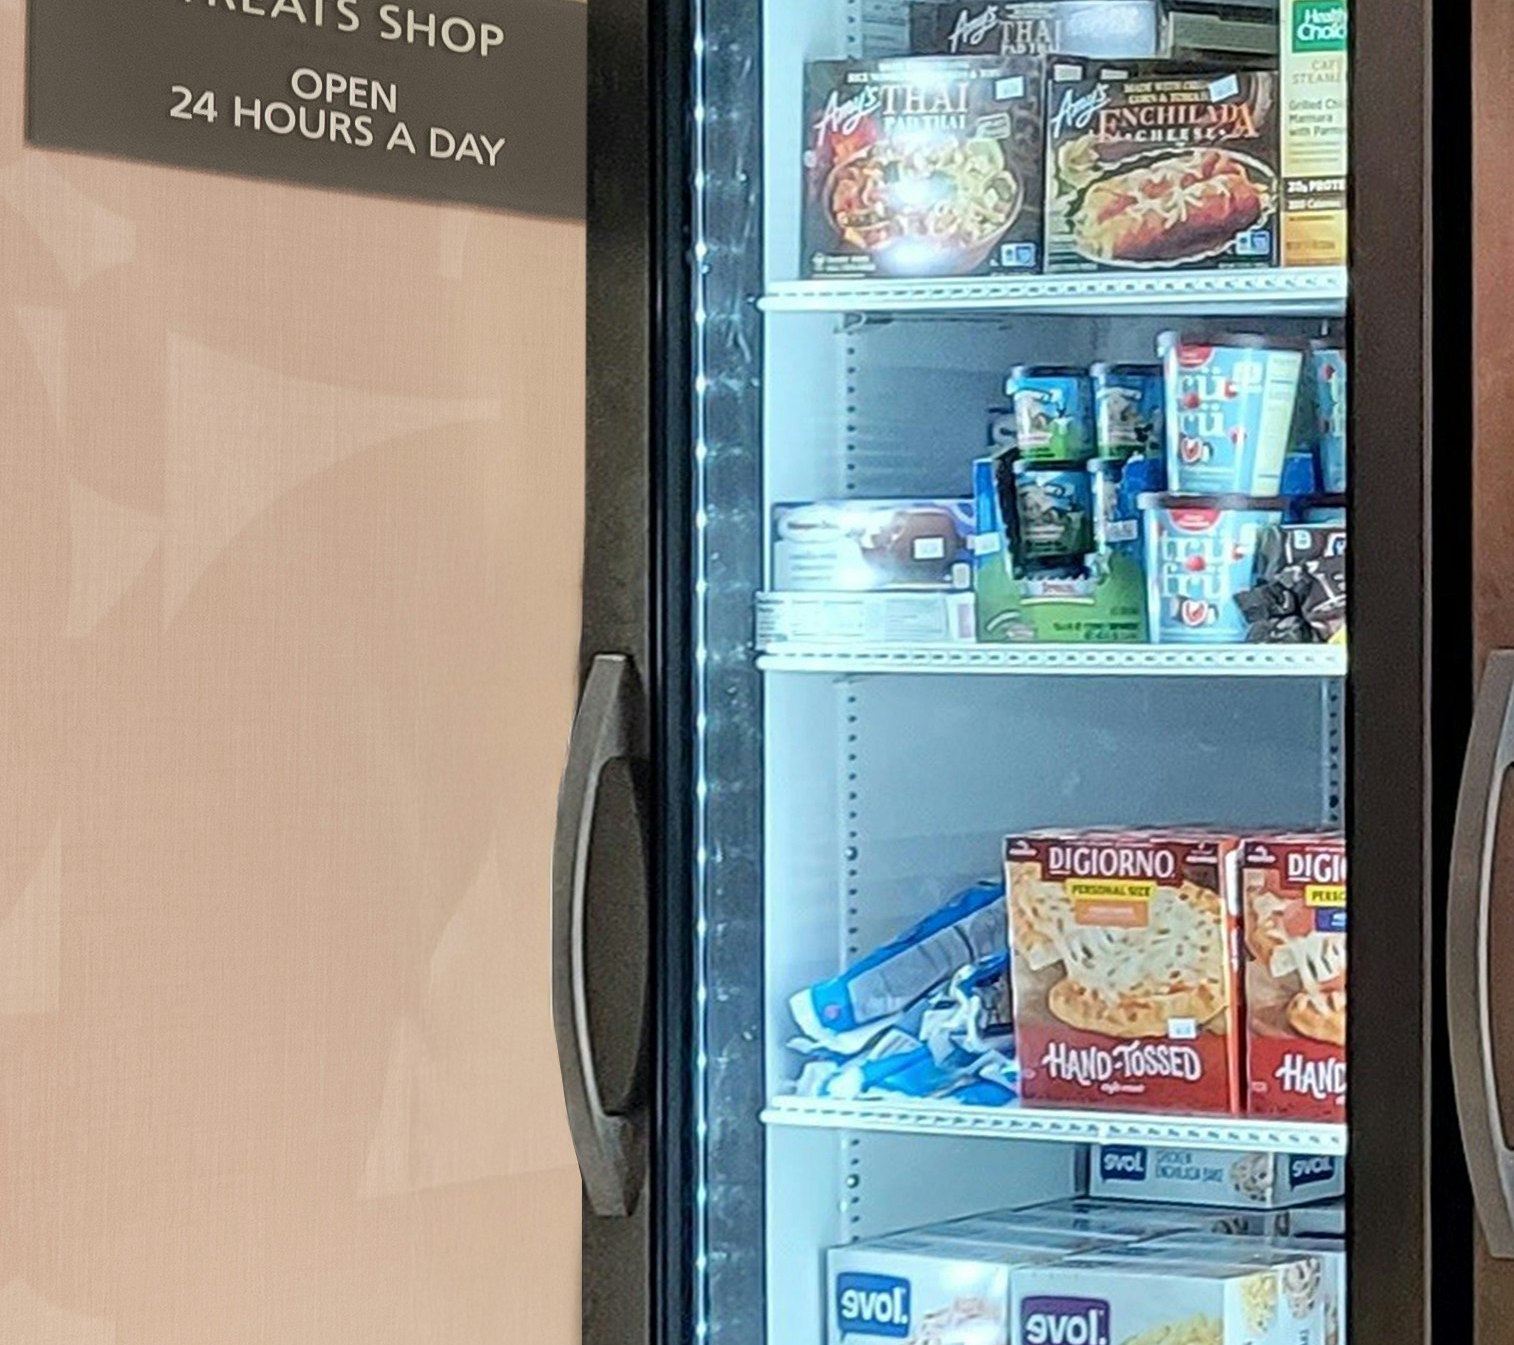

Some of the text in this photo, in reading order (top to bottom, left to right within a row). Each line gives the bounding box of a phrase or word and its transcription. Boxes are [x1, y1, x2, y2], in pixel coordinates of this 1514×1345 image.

[379, 4, 505, 56] SHOP
[291, 68, 397, 113] OPEN
[818, 83, 969, 145] Amy's THAI
[169, 86, 505, 166] 24 HOURS A DAY
[1048, 847, 1175, 879] DIGIORNO
[1042, 1040, 1201, 1083] HAND-TOSSED
